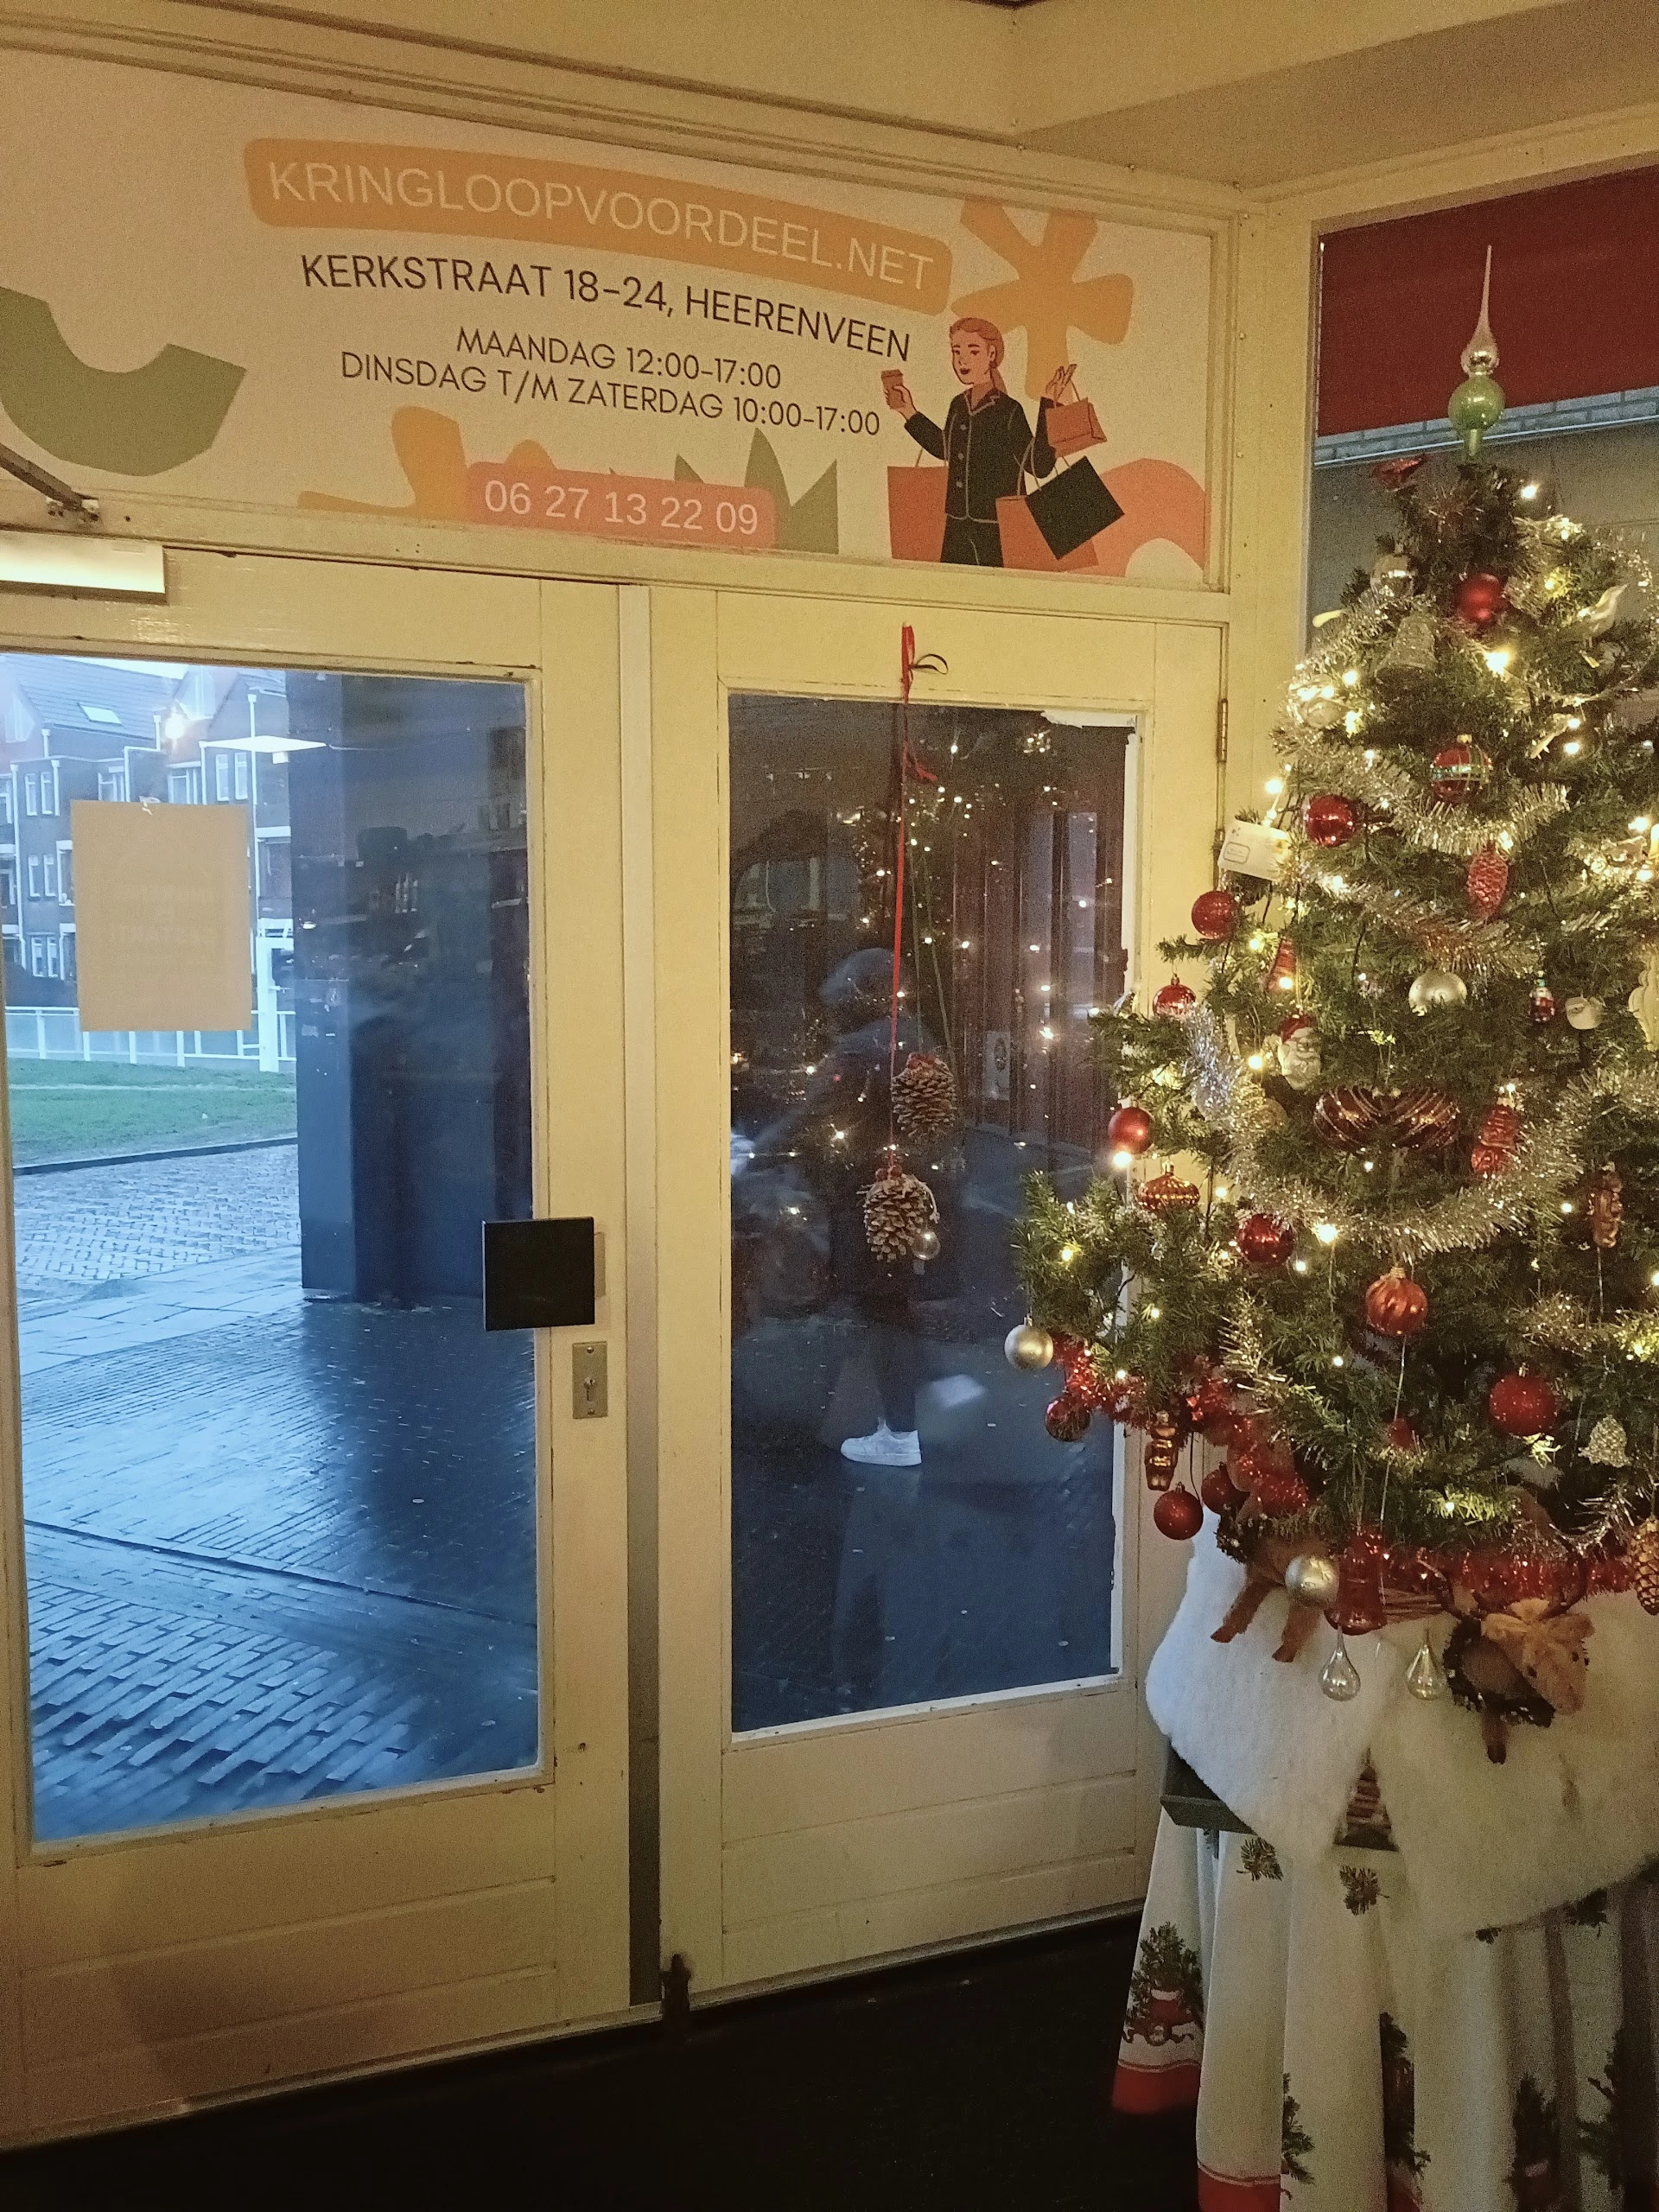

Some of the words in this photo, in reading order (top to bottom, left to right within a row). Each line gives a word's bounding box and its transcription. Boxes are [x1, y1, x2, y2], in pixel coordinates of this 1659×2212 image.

[269, 161, 934, 290] KRINGLOOPVOORDEEL.NET
[301, 254, 551, 299] KERKSTRAAT
[565, 270, 675, 319] 18-24,
[685, 286, 911, 361] HEERENVEEN
[341, 352, 487, 393] DINSDAG
[498, 370, 558, 404] T/M
[569, 378, 724, 420] ZATERDAG
[734, 397, 880, 436] 10:00-17:00
[456, 327, 615, 370] MAANDAG
[627, 347, 781, 390] 12:00-17:00
[484, 480, 531, 515] 06
[543, 486, 590, 519] 27
[605, 491, 647, 525] 13
[661, 497, 702, 531] 22
[715, 502, 759, 535] 09
